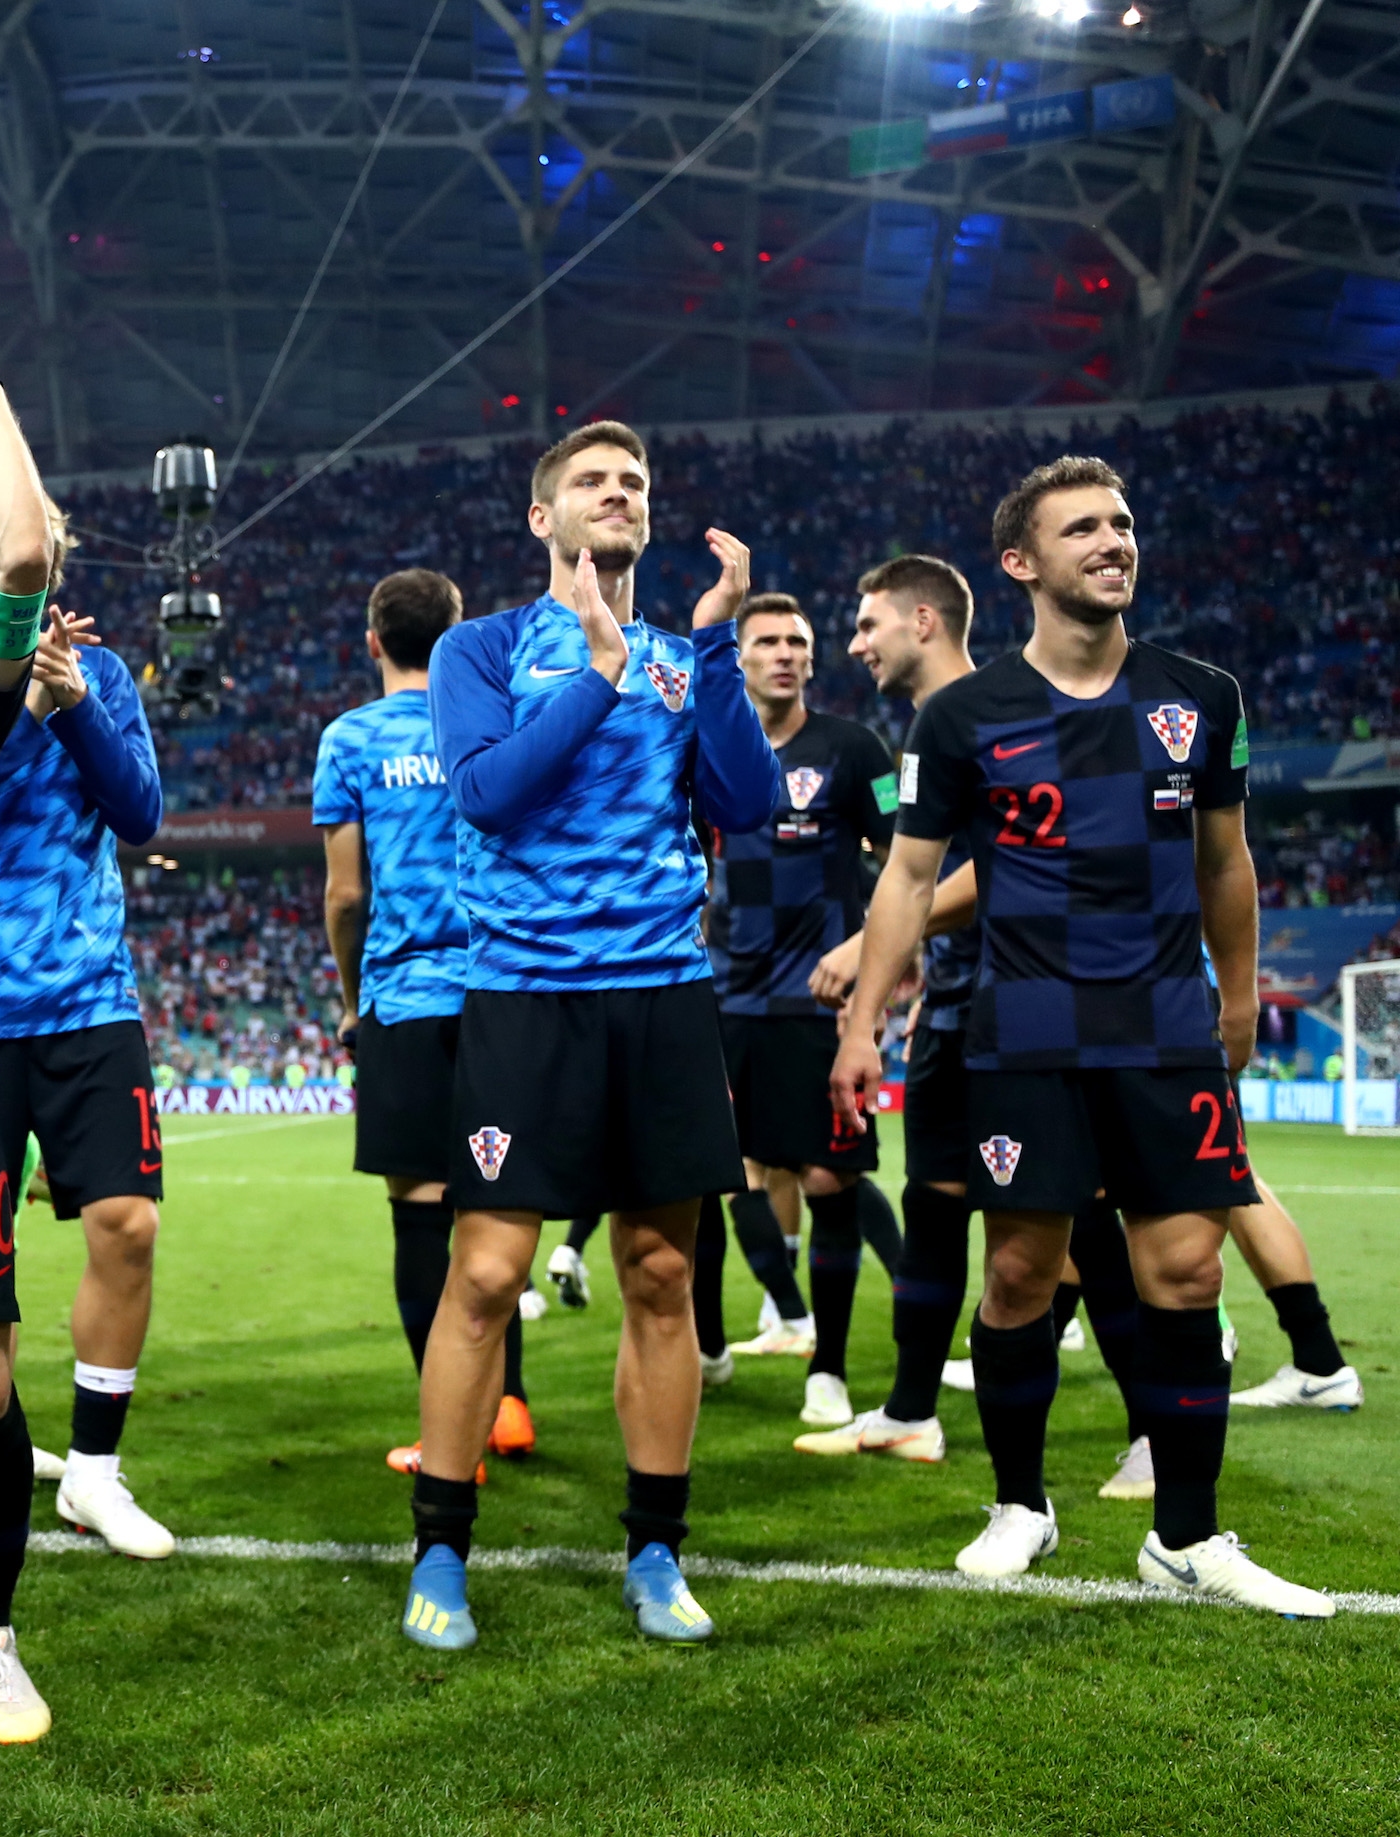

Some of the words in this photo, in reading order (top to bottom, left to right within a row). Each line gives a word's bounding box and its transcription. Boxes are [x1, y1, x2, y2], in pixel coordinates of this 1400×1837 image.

[1018, 104, 1072, 131] FIFA
[989, 782, 1068, 848] 22
[214, 1086, 354, 1114] AIRWAYS
